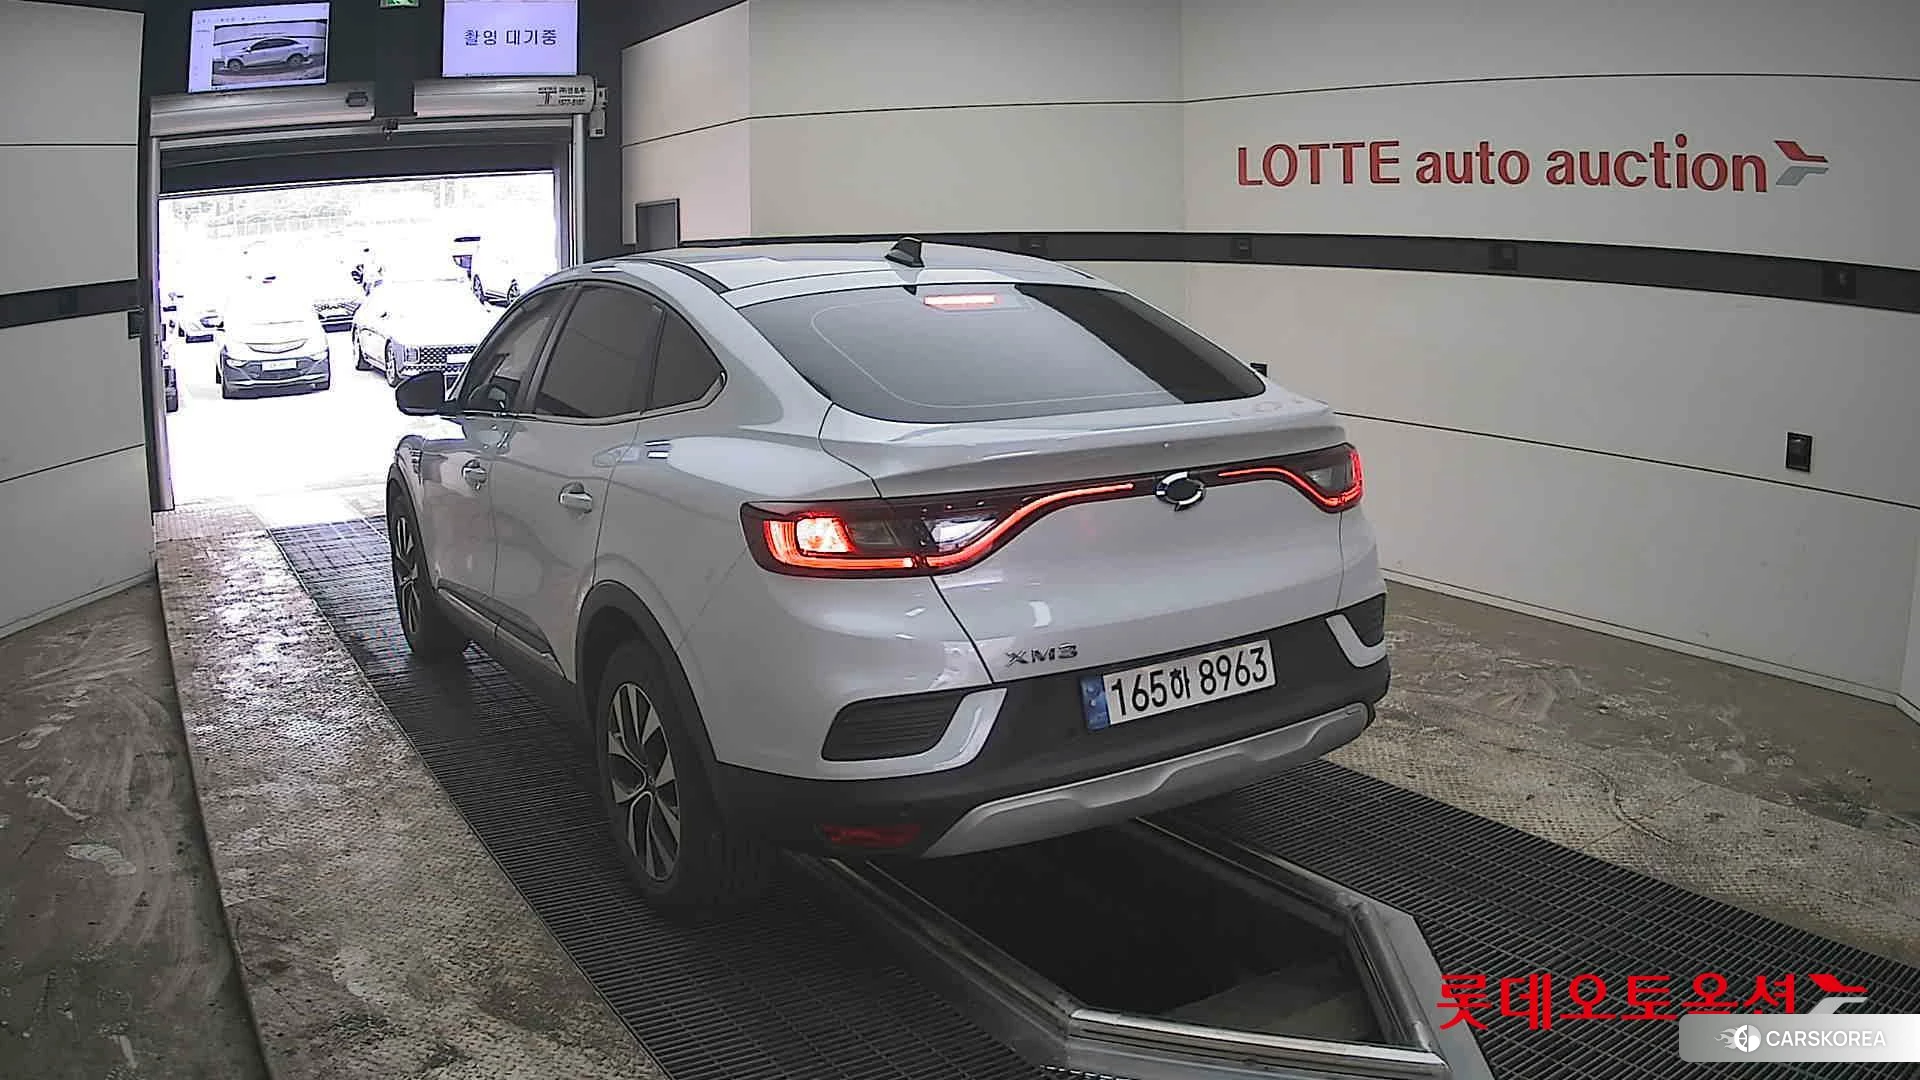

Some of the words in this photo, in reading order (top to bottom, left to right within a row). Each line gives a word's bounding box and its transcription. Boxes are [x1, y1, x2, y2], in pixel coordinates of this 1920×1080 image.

[505, 29, 557, 46] 대기중
[1238, 141, 1400, 187] LOTTE
[1415, 141, 1530, 186] auto
[1545, 134, 1768, 193] auction
[1006, 642, 1078, 666] XM3
[1111, 666, 1191, 716] 165하
[1199, 647, 1267, 695] 8963
